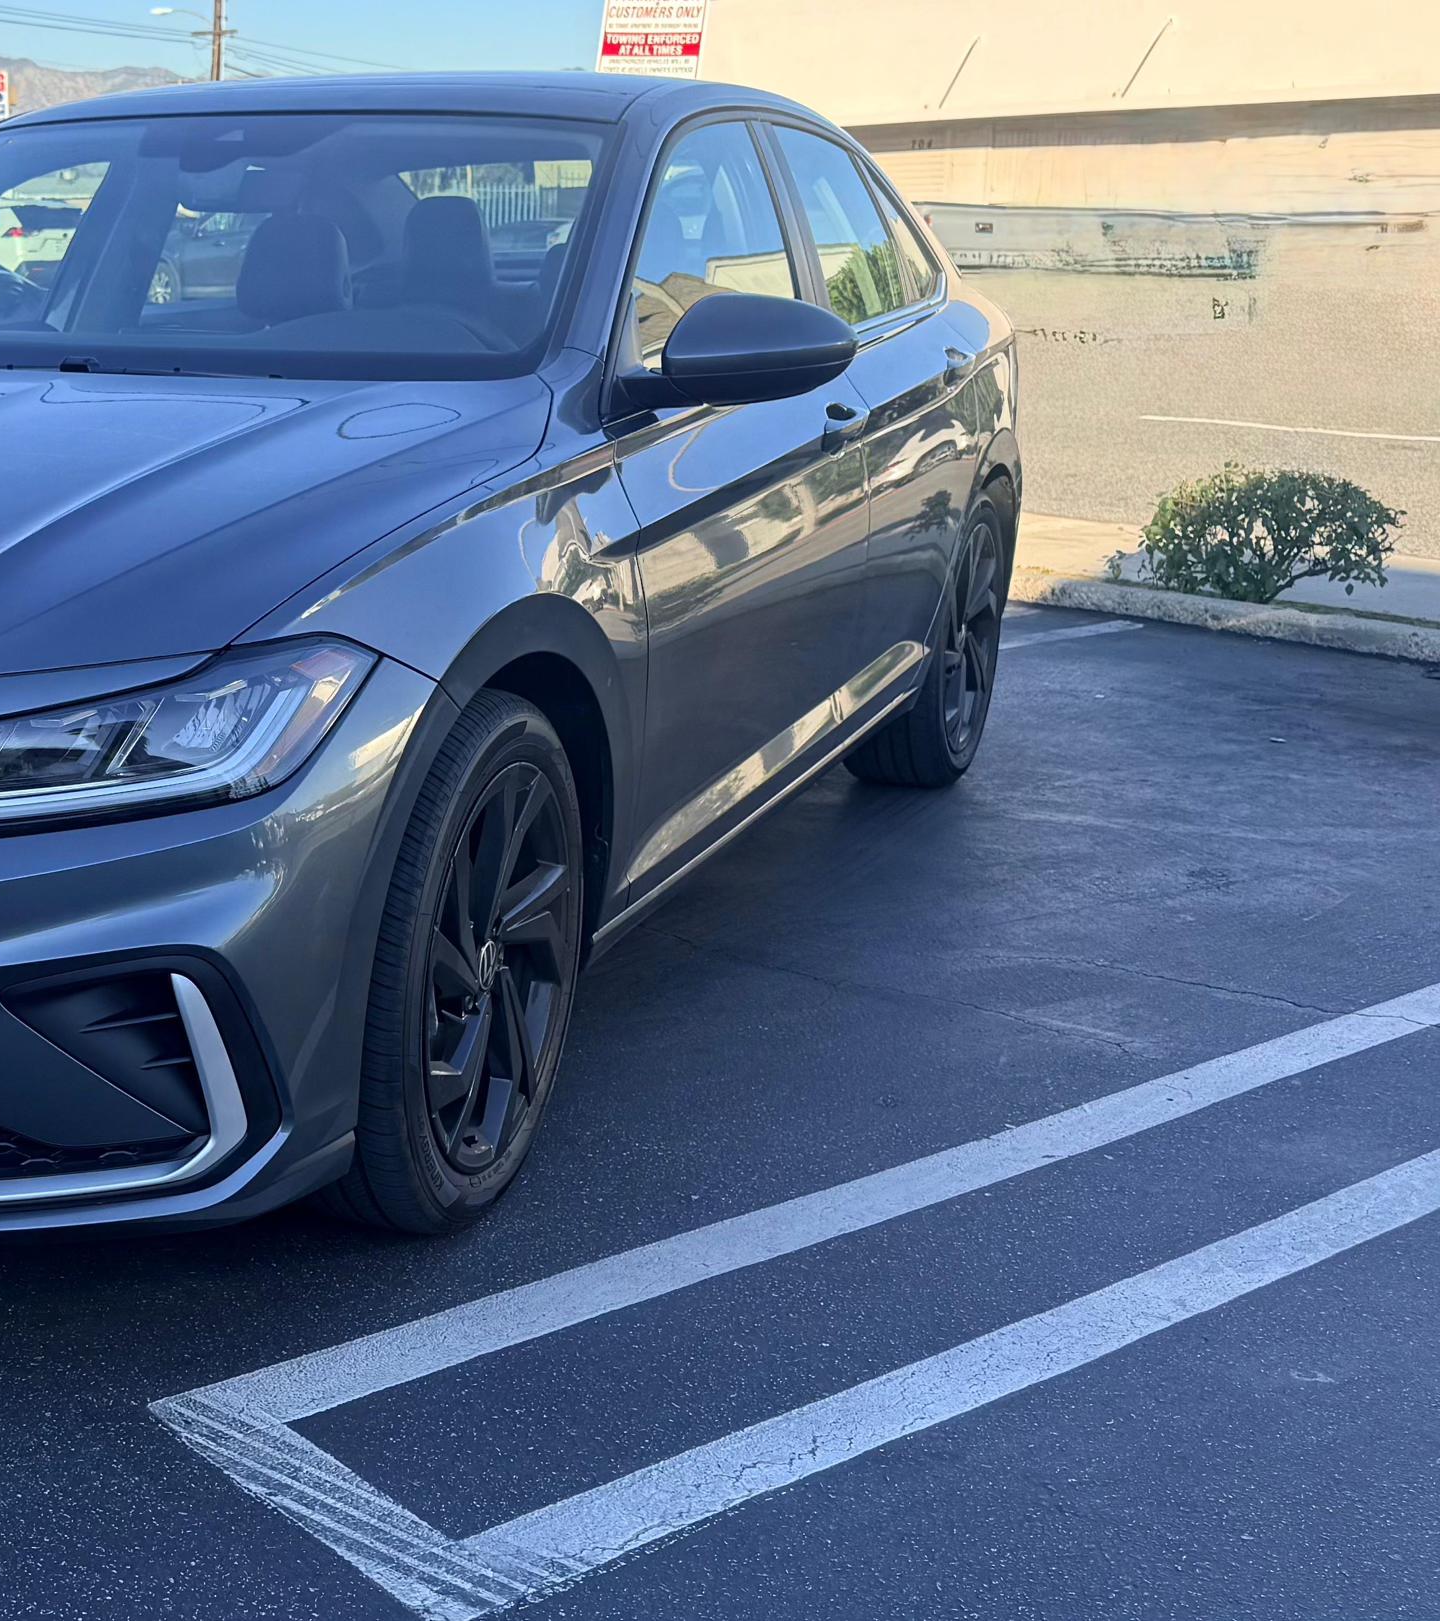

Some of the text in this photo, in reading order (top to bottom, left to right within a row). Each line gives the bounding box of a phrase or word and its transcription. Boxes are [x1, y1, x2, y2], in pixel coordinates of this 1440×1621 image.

[608, 6, 703, 18] CUSTOMERS ONLY
[606, 33, 700, 45] TOWING ENFORCED
[618, 45, 683, 56] AT ALL TIMES
